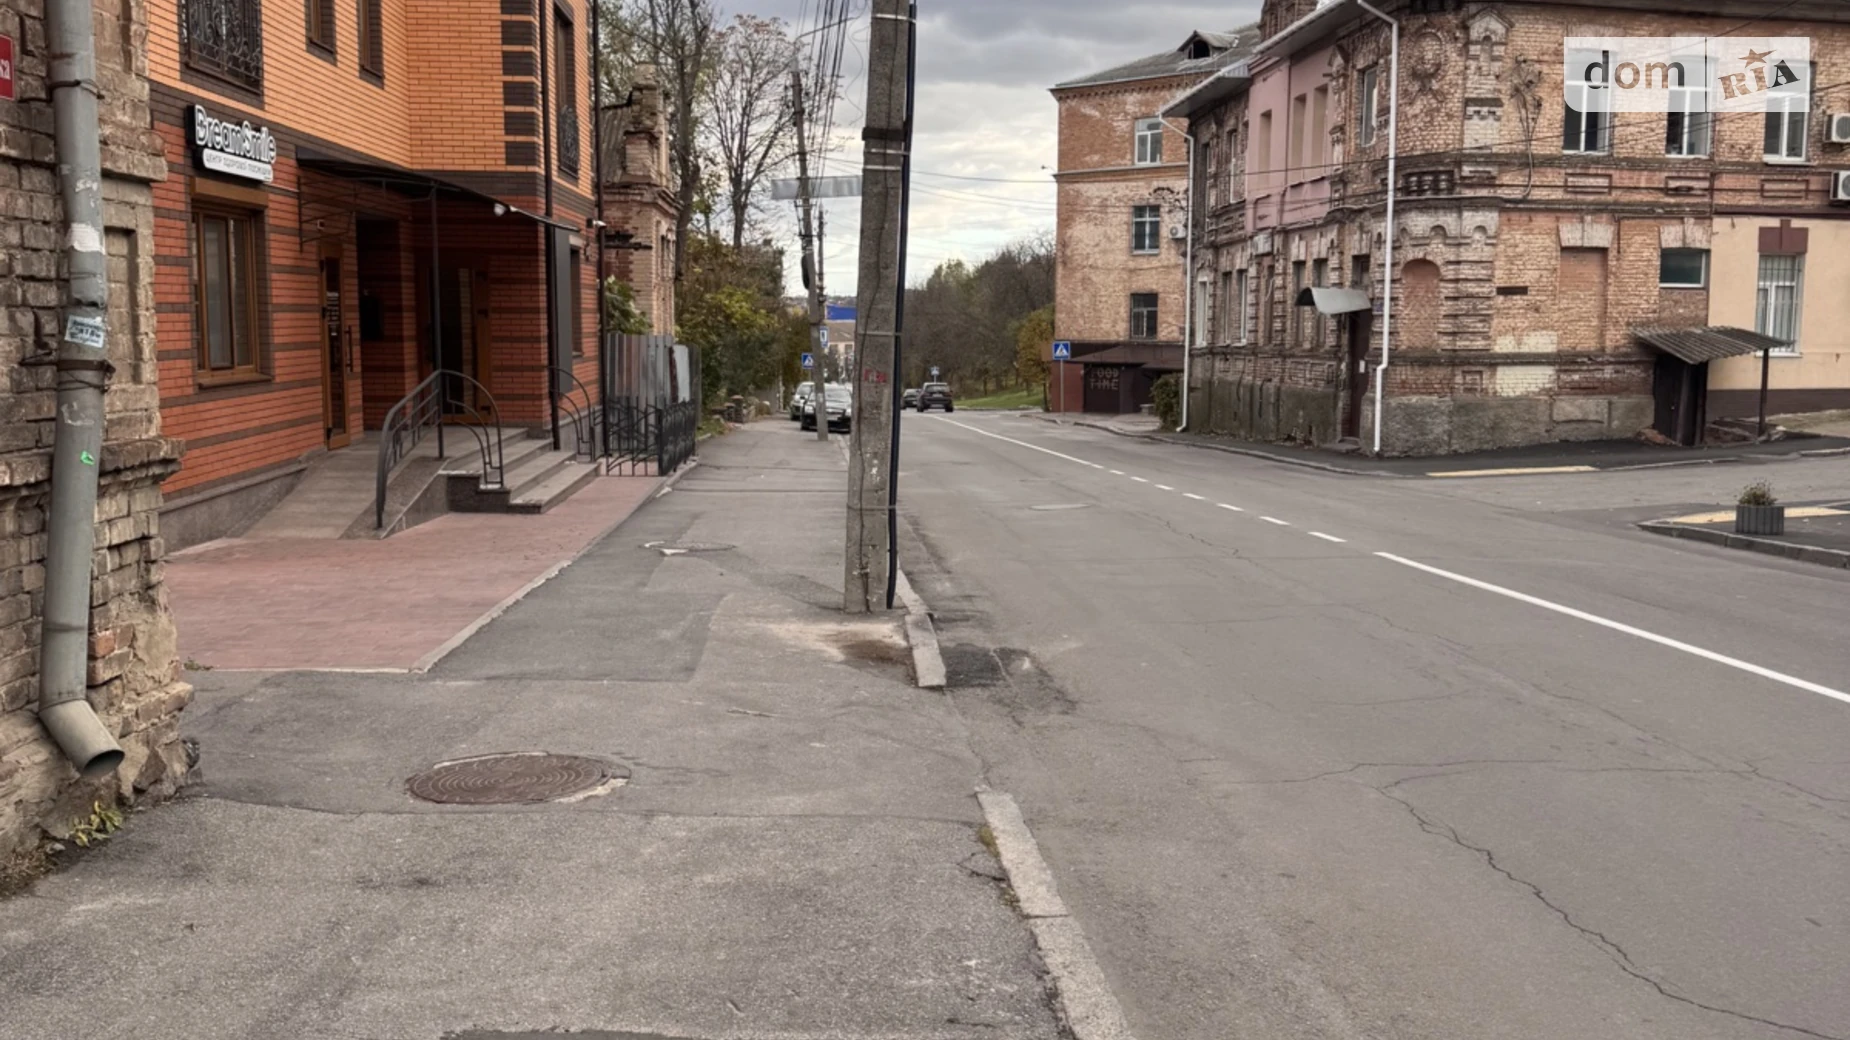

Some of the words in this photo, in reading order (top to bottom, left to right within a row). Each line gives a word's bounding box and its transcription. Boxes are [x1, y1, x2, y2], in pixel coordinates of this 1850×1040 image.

[195, 104, 276, 163] DreamSmile
[1091, 367, 1119, 378] FOOD
[1089, 378, 1119, 390] TIME
